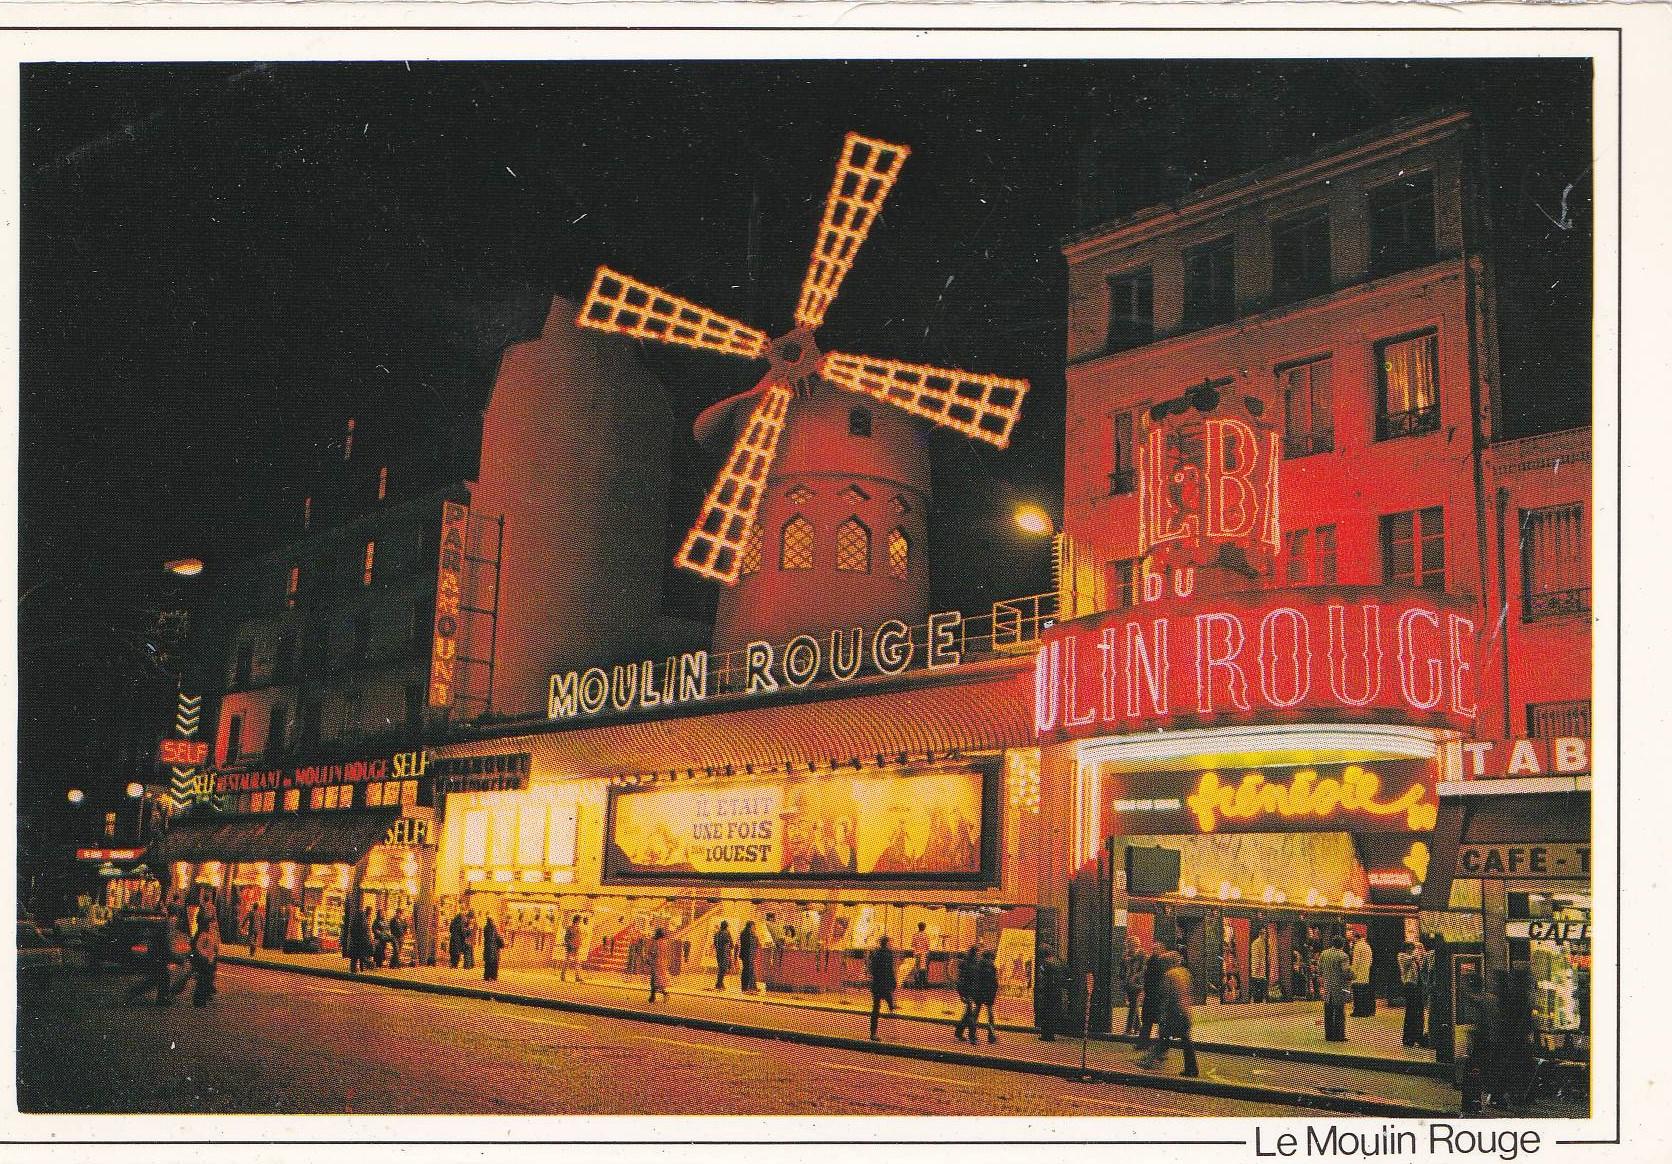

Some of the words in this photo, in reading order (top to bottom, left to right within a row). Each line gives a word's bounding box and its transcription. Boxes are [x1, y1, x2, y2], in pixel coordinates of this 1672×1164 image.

[547, 650, 708, 719] MOULIN
[745, 611, 962, 694] ROUGE
[1195, 604, 1477, 718] ROUGE
[164, 741, 208, 763] SELF
[392, 751, 430, 778] SELF
[1462, 736, 1589, 776] TAB
[385, 818, 427, 844] SELF
[693, 822, 723, 840] UNE
[727, 820, 773, 839] FOIS
